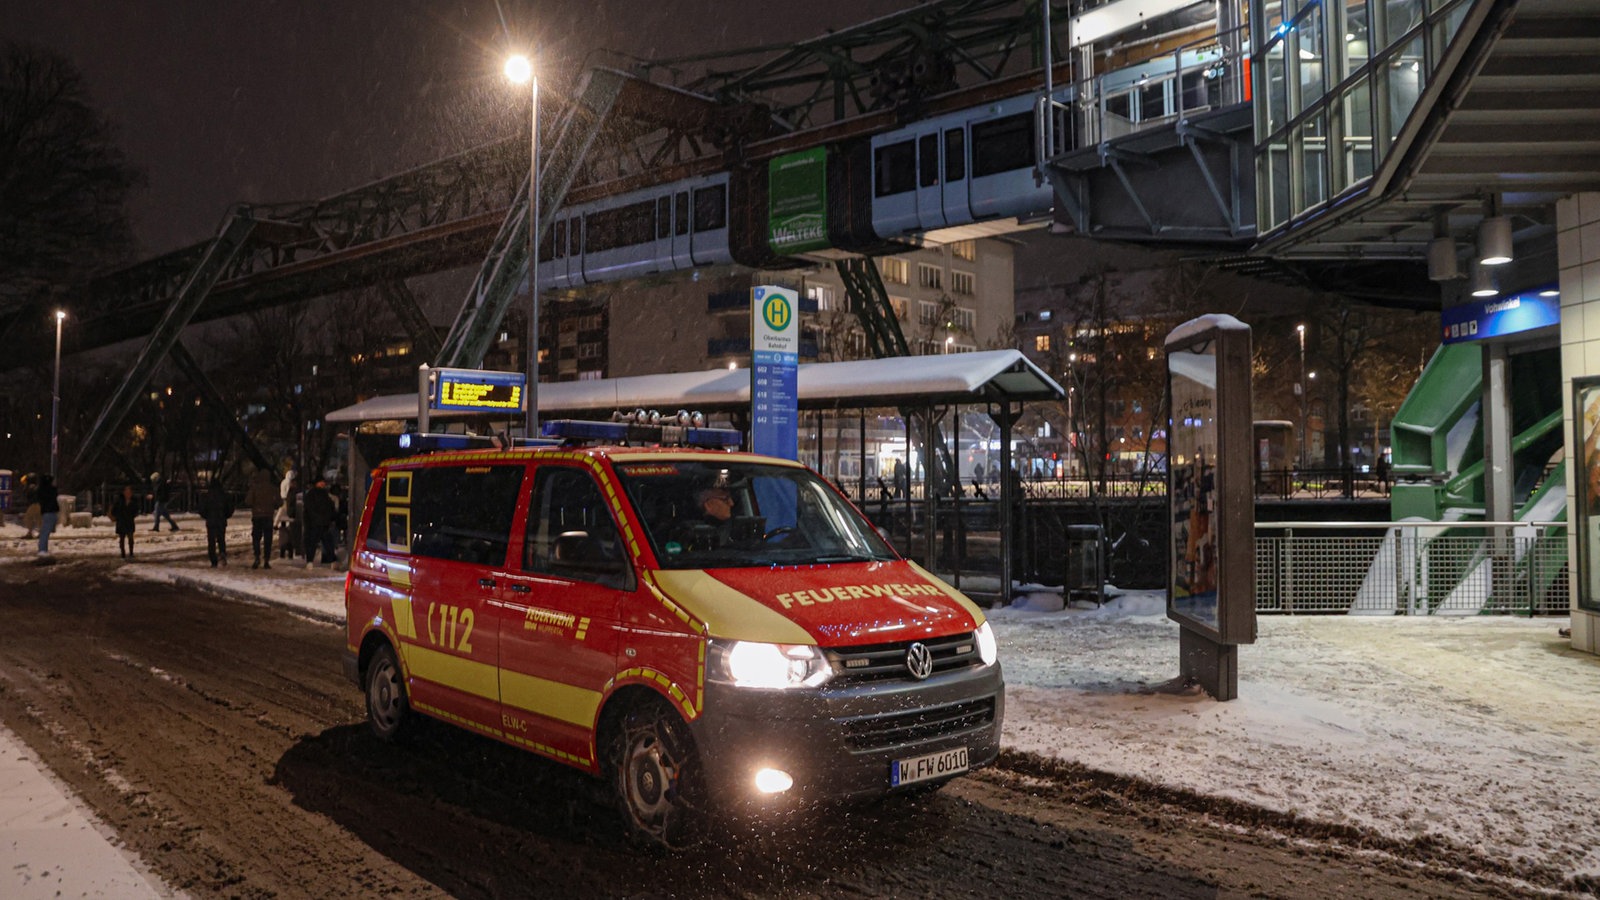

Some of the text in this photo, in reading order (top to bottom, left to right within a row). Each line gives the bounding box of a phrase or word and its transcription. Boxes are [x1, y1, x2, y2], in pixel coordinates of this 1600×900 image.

[771, 301, 785, 324] H
[1484, 296, 1521, 315] Vohwinkel
[776, 582, 946, 610] FEUERWEHR
[438, 604, 475, 654] 112
[525, 607, 576, 628] FEUERWEHR
[502, 714, 528, 732] ELW-C
[900, 763, 909, 780] W
[917, 759, 935, 778] FW
[937, 750, 967, 773] 6010
